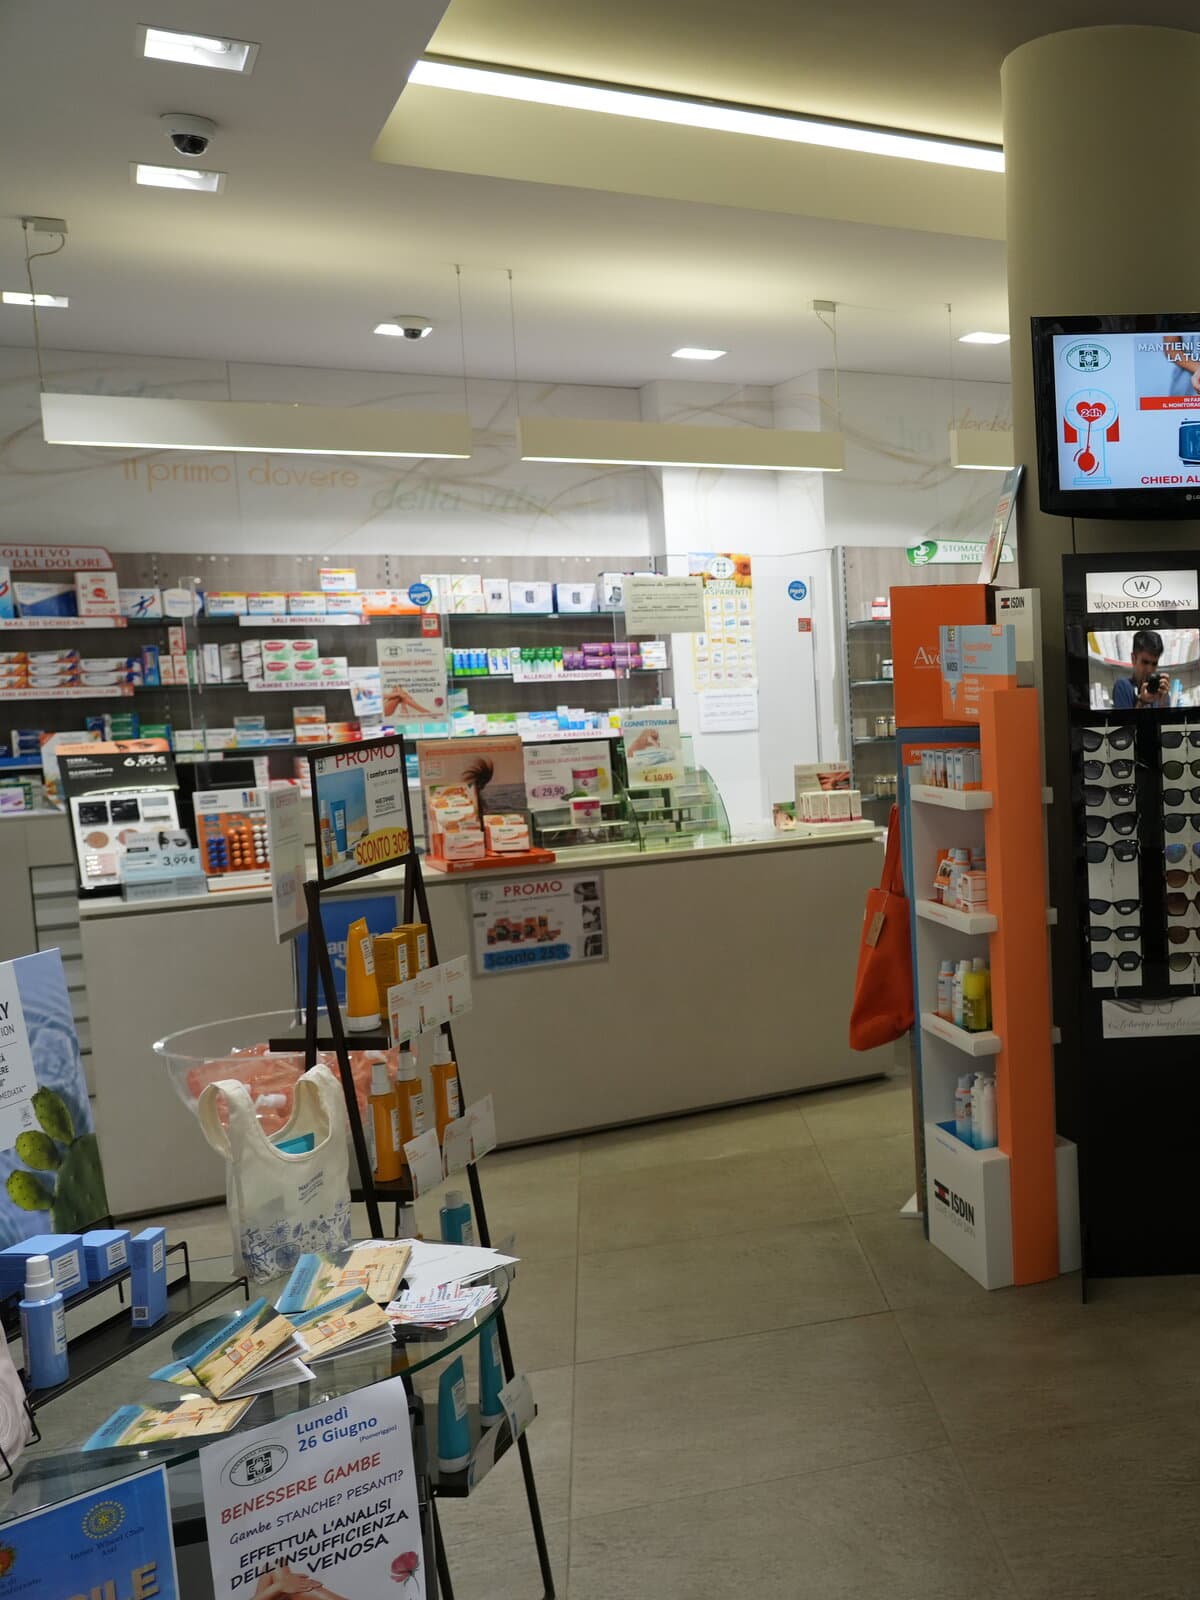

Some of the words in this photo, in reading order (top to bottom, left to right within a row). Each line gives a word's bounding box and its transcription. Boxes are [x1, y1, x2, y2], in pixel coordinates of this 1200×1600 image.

[1138, 340, 1194, 352] MANTIENI
[1167, 352, 1182, 363] LA
[1080, 407, 1102, 418] 24h
[147, 456, 231, 493] primo
[247, 457, 360, 490] dovere
[1141, 474, 1183, 485] CHIEDI
[942, 543, 985, 553] STOMAC
[12, 558, 41, 569] DAL
[44, 558, 102, 569] DOLORE
[1010, 596, 1025, 609] ISDIN
[1093, 600, 1139, 610] WONDER
[1141, 599, 1193, 609] COMPANY
[271, 616, 289, 624] SALI
[1125, 615, 1151, 628] 19,00
[624, 719, 667, 728] CONNETTIVINA
[335, 744, 396, 769] PROMO
[355, 835, 391, 865] SCONTO
[503, 880, 563, 898] PROMO
[950, 1191, 975, 1227] ISDIN
[296, 1406, 349, 1436] Lunedì
[298, 1436, 318, 1453] 26
[322, 1416, 378, 1445] Giugno
[220, 1475, 318, 1525] BENESSERE
[323, 1452, 381, 1485] GAMBE
[229, 1520, 273, 1546] Gambe
[276, 1492, 343, 1528] STANCHE?
[346, 1469, 404, 1500] PESANTI?
[239, 1528, 318, 1569] EFFETTUA
[322, 1498, 392, 1536] L'ANALISI
[230, 1509, 409, 1591] DELL'INSUFFICIENZA
[306, 1533, 390, 1575] VENOSA
